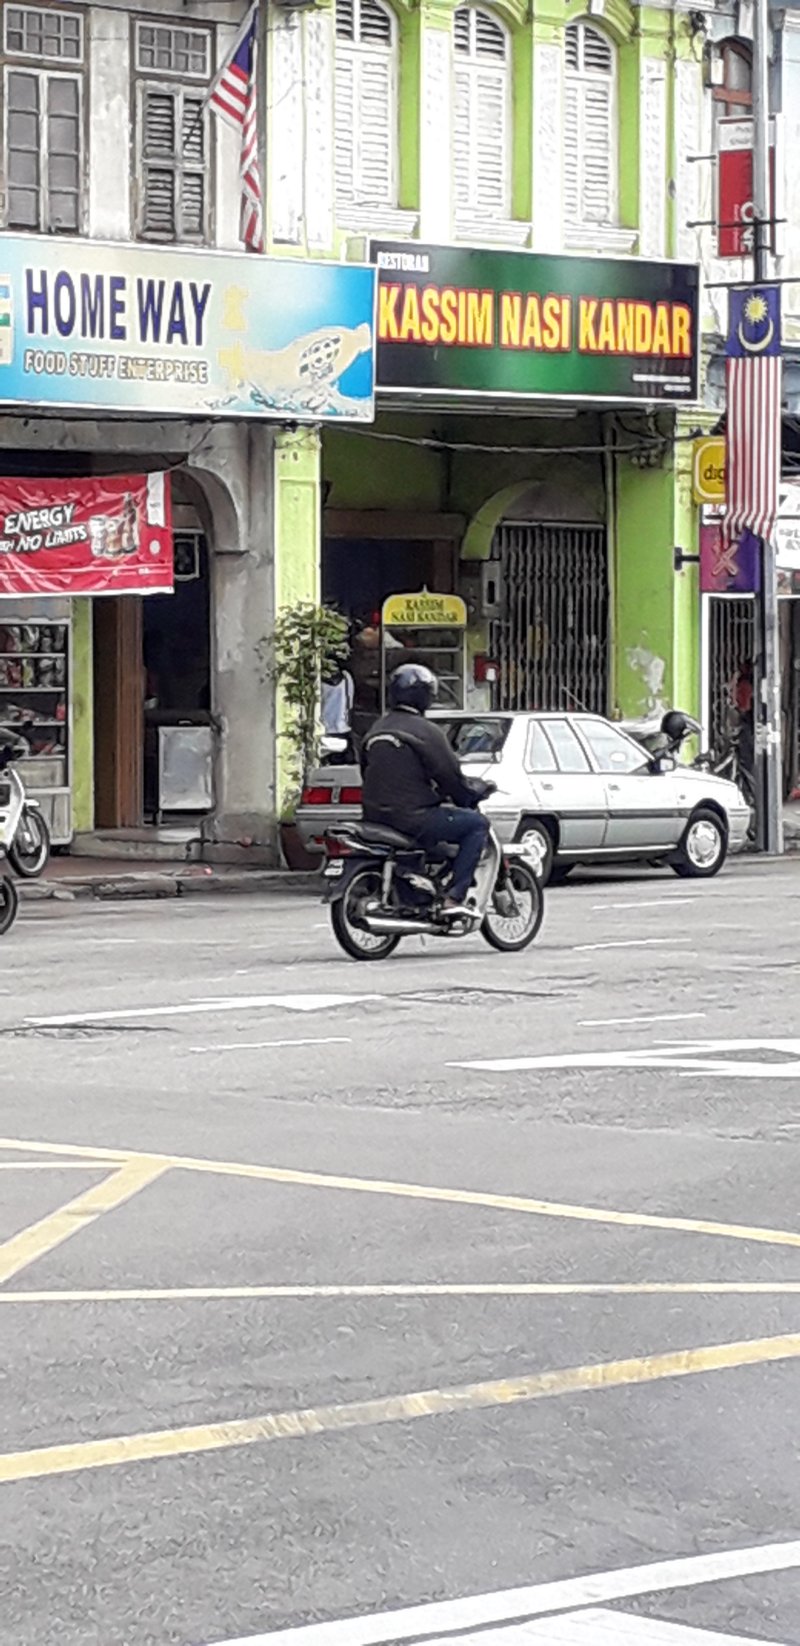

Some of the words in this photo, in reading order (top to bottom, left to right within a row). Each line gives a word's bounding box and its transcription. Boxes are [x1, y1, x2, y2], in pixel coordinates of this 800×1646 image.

[377, 251, 429, 272] RESTORAN
[25, 268, 127, 341] HOME
[137, 277, 211, 346] WAY
[378, 283, 494, 346] KASSIM
[500, 291, 571, 352] NASI
[578, 297, 692, 357] KANDAR
[24, 349, 66, 374] FOOD
[69, 352, 116, 377] STUFF
[117, 355, 208, 383] ENTERPRISE
[703, 463, 724, 484] dig
[4, 503, 75, 534] ENERGY
[16, 534, 42, 553] NO
[45, 525, 87, 548] LIMITS
[405, 599, 444, 611] KASSIM
